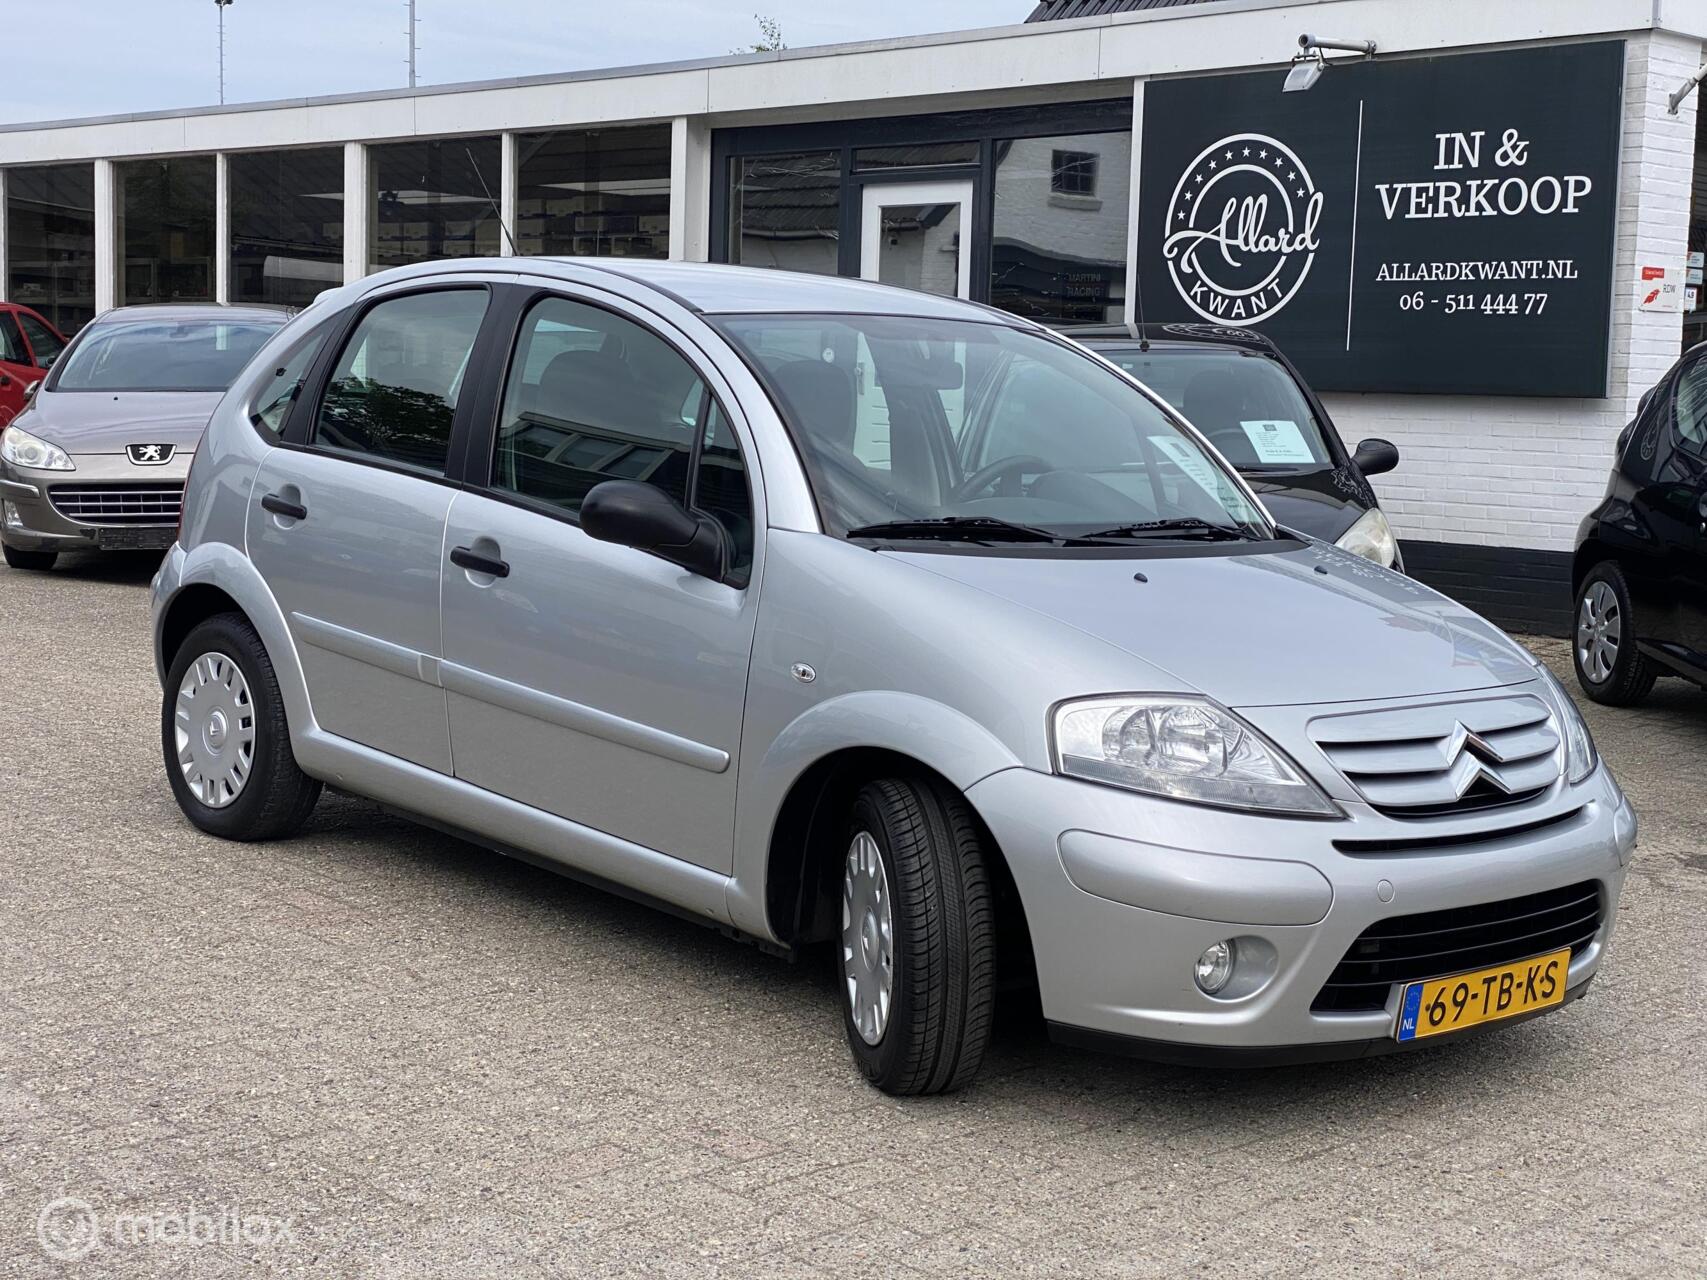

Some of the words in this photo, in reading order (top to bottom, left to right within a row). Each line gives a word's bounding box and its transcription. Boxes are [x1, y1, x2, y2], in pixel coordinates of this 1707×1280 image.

[1433, 130, 1486, 170] IN
[1494, 128, 1530, 167] &
[1374, 175, 1592, 220] VERKOOP
[1162, 191, 1324, 273] Allard
[1067, 272, 1101, 283] MARTINI
[1375, 259, 1578, 282] ALLARDKWANT.NL
[1189, 277, 1284, 318] KWANT
[1399, 290, 1424, 311] 06
[1444, 293, 1476, 314] 511
[1480, 293, 1519, 315] 444
[1523, 293, 1548, 315] 77
[1402, 1018, 1415, 1030] NL
[1428, 960, 1559, 1027] 69-TB-KS
